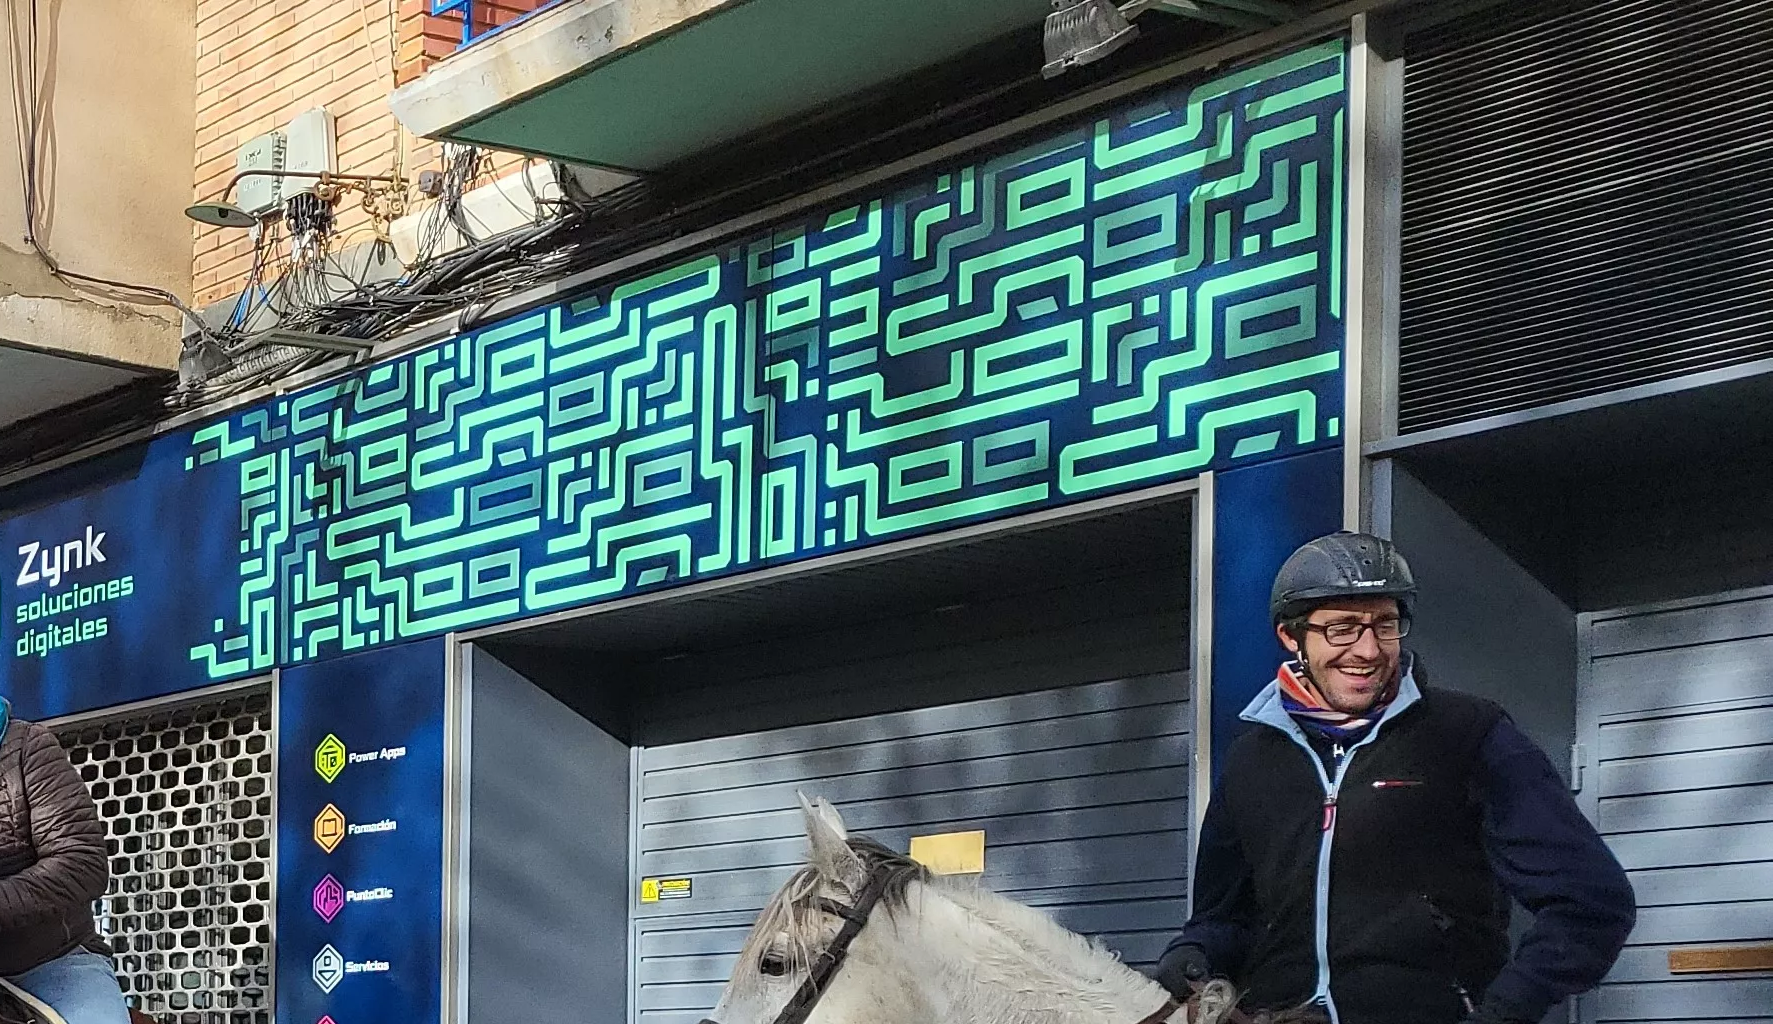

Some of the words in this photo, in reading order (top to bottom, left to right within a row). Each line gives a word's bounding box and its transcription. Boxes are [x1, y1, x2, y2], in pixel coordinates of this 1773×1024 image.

[16, 525, 107, 587] Zynk
[16, 574, 135, 624] soluciones
[16, 617, 108, 657] digitales
[349, 751, 378, 763] Power
[379, 746, 405, 760] Apps
[348, 819, 396, 834] Formación
[345, 960, 389, 973] Servicios
